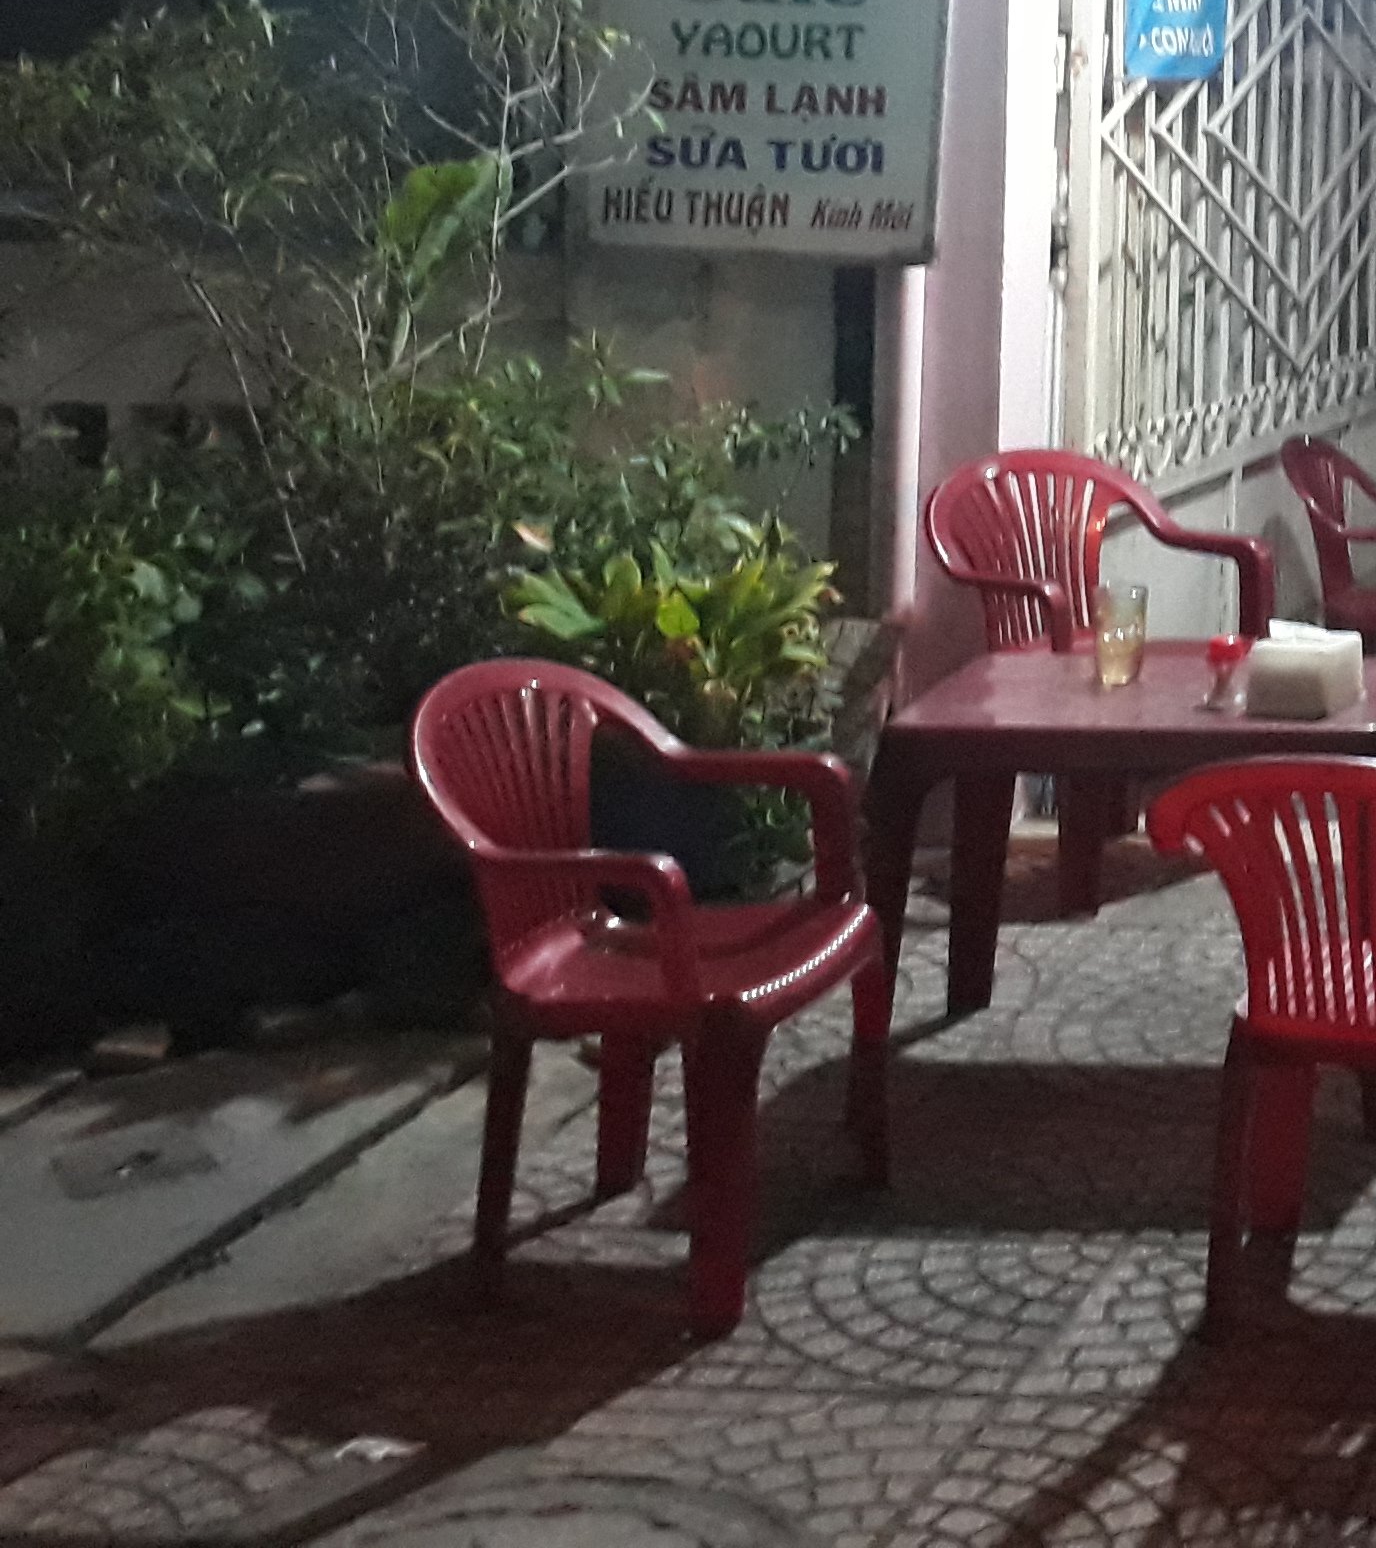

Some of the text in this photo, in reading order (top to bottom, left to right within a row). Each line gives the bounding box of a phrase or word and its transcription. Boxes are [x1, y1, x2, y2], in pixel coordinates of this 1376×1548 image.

[670, 17, 866, 61] YAOURT
[766, 132, 885, 177] TƯƠI
[601, 174, 674, 226] HIẾU
[685, 181, 790, 238] THUẬN
